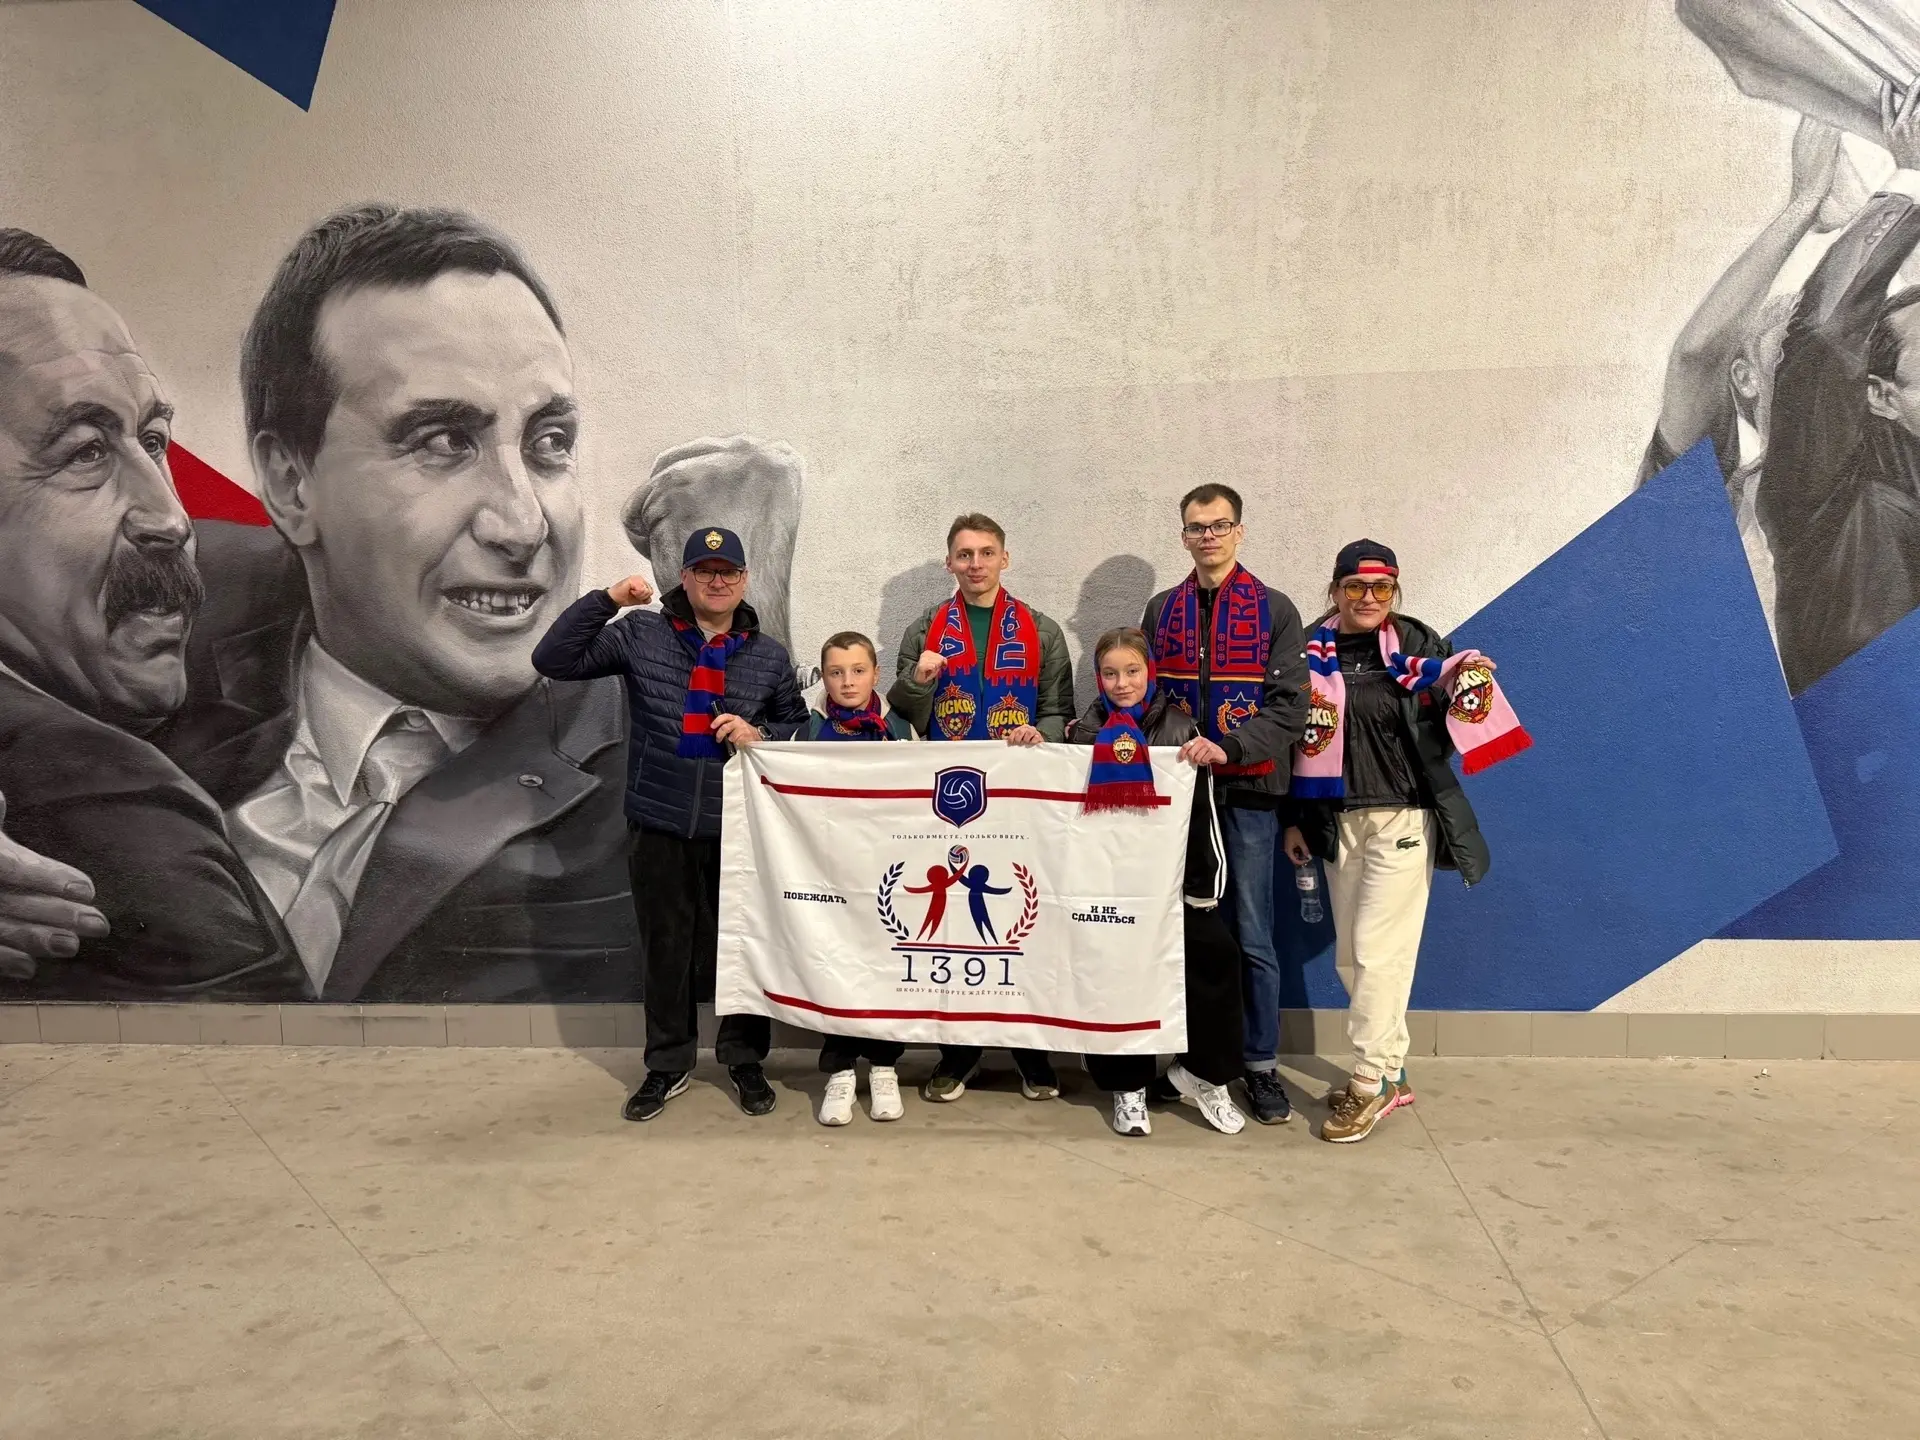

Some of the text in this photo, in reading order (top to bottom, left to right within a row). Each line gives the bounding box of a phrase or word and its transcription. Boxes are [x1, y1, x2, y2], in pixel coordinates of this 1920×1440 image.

[994, 593, 1026, 670] ПФ
[1229, 582, 1259, 665] ЦСКА
[938, 699, 973, 718] ЦСКА
[990, 710, 1026, 728] ЦСКА
[783, 891, 847, 904] ПОБЕЖДАТЬ
[1071, 912, 1136, 925] СДАВАТЬСЯ
[1090, 905, 1117, 915] И НЕ
[901, 954, 1015, 987] 1391
[934, 988, 966, 996] СПОРТЕ
